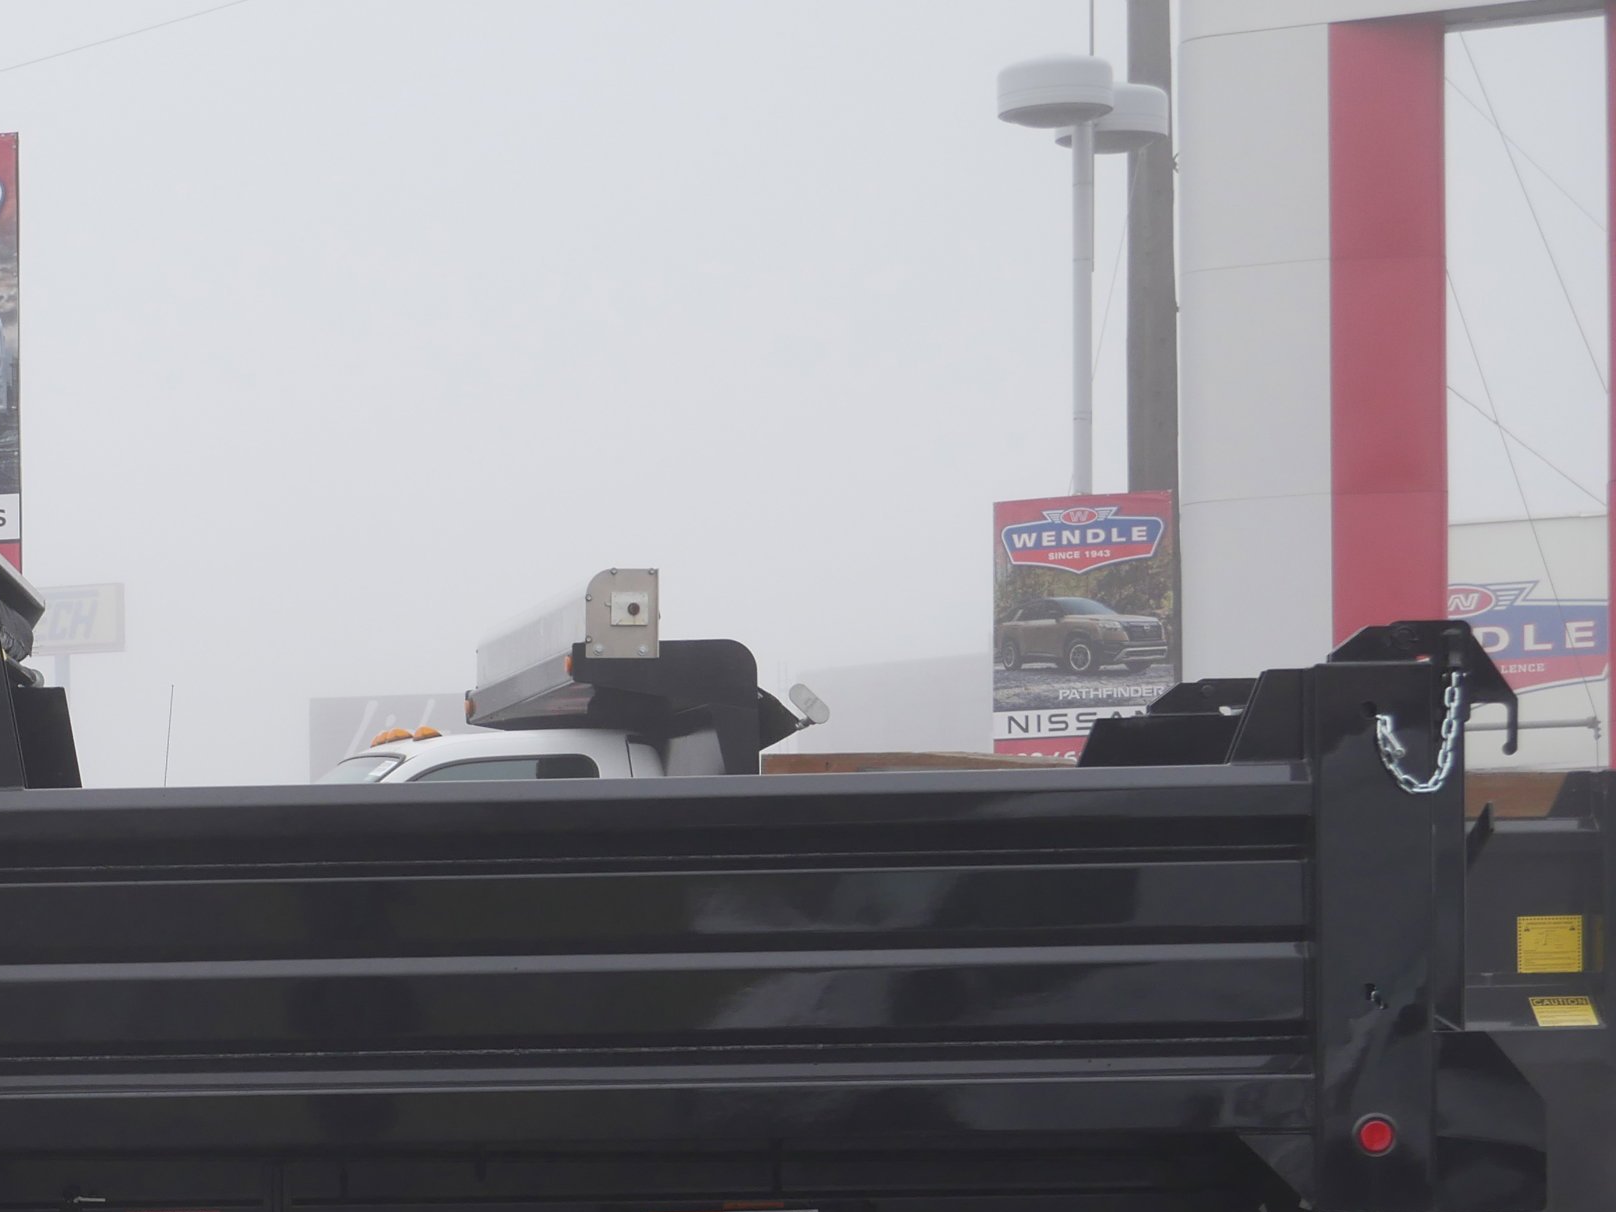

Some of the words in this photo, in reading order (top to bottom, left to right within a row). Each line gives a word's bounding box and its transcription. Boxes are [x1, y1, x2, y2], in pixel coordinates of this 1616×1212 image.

[1012, 527, 1148, 548] WENDLE
[1048, 551, 1080, 560] SINCE
[1084, 550, 1111, 558] 1943
[1058, 686, 1165, 700] PATHFINDER
[1532, 997, 1589, 1006] CAUTION
